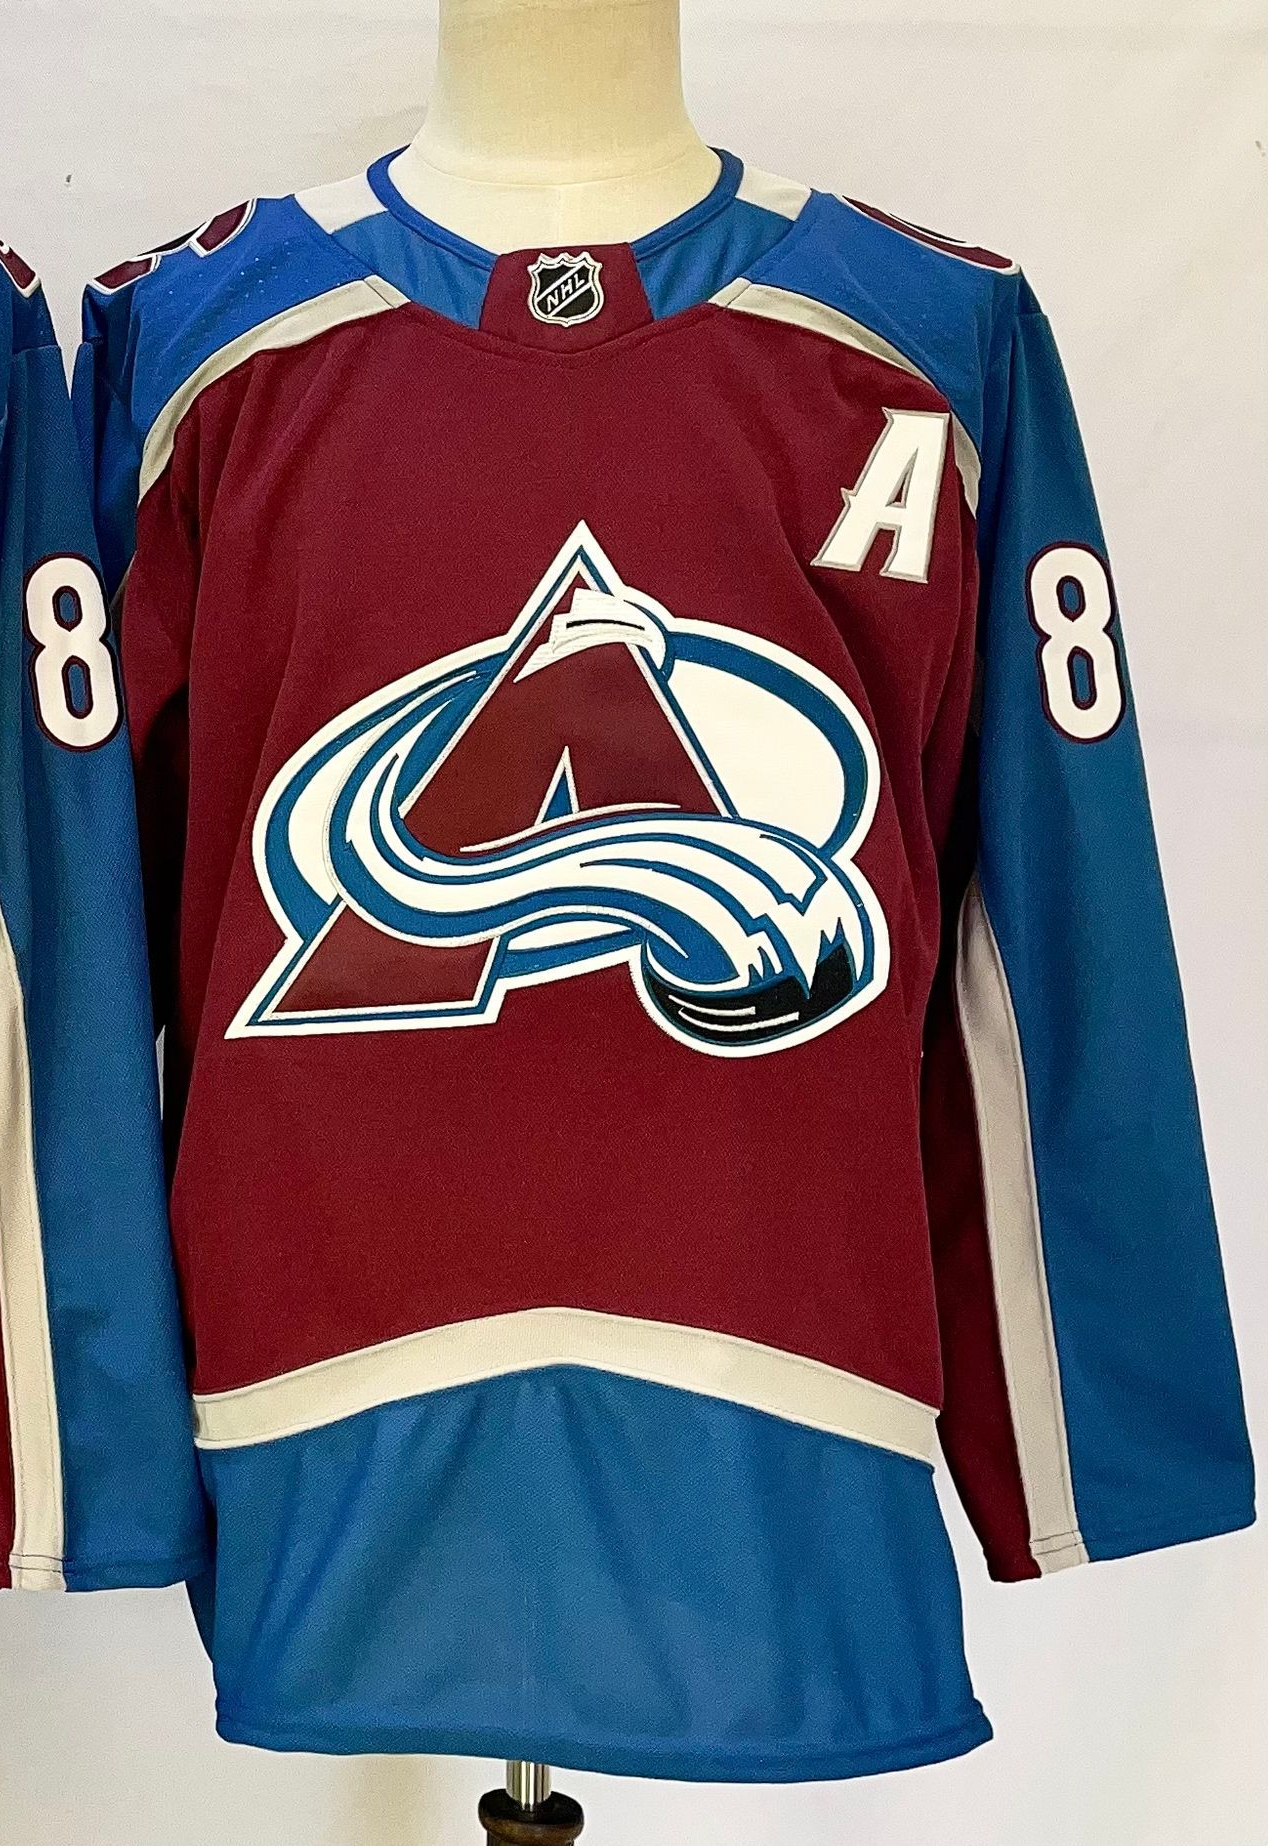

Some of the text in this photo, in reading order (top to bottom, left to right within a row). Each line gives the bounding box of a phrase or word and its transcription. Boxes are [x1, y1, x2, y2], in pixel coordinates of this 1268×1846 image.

[546, 273, 585, 312] NHL
[810, 406, 951, 585] A
[22, 552, 125, 753] 8
[1025, 540, 1127, 744] 8
